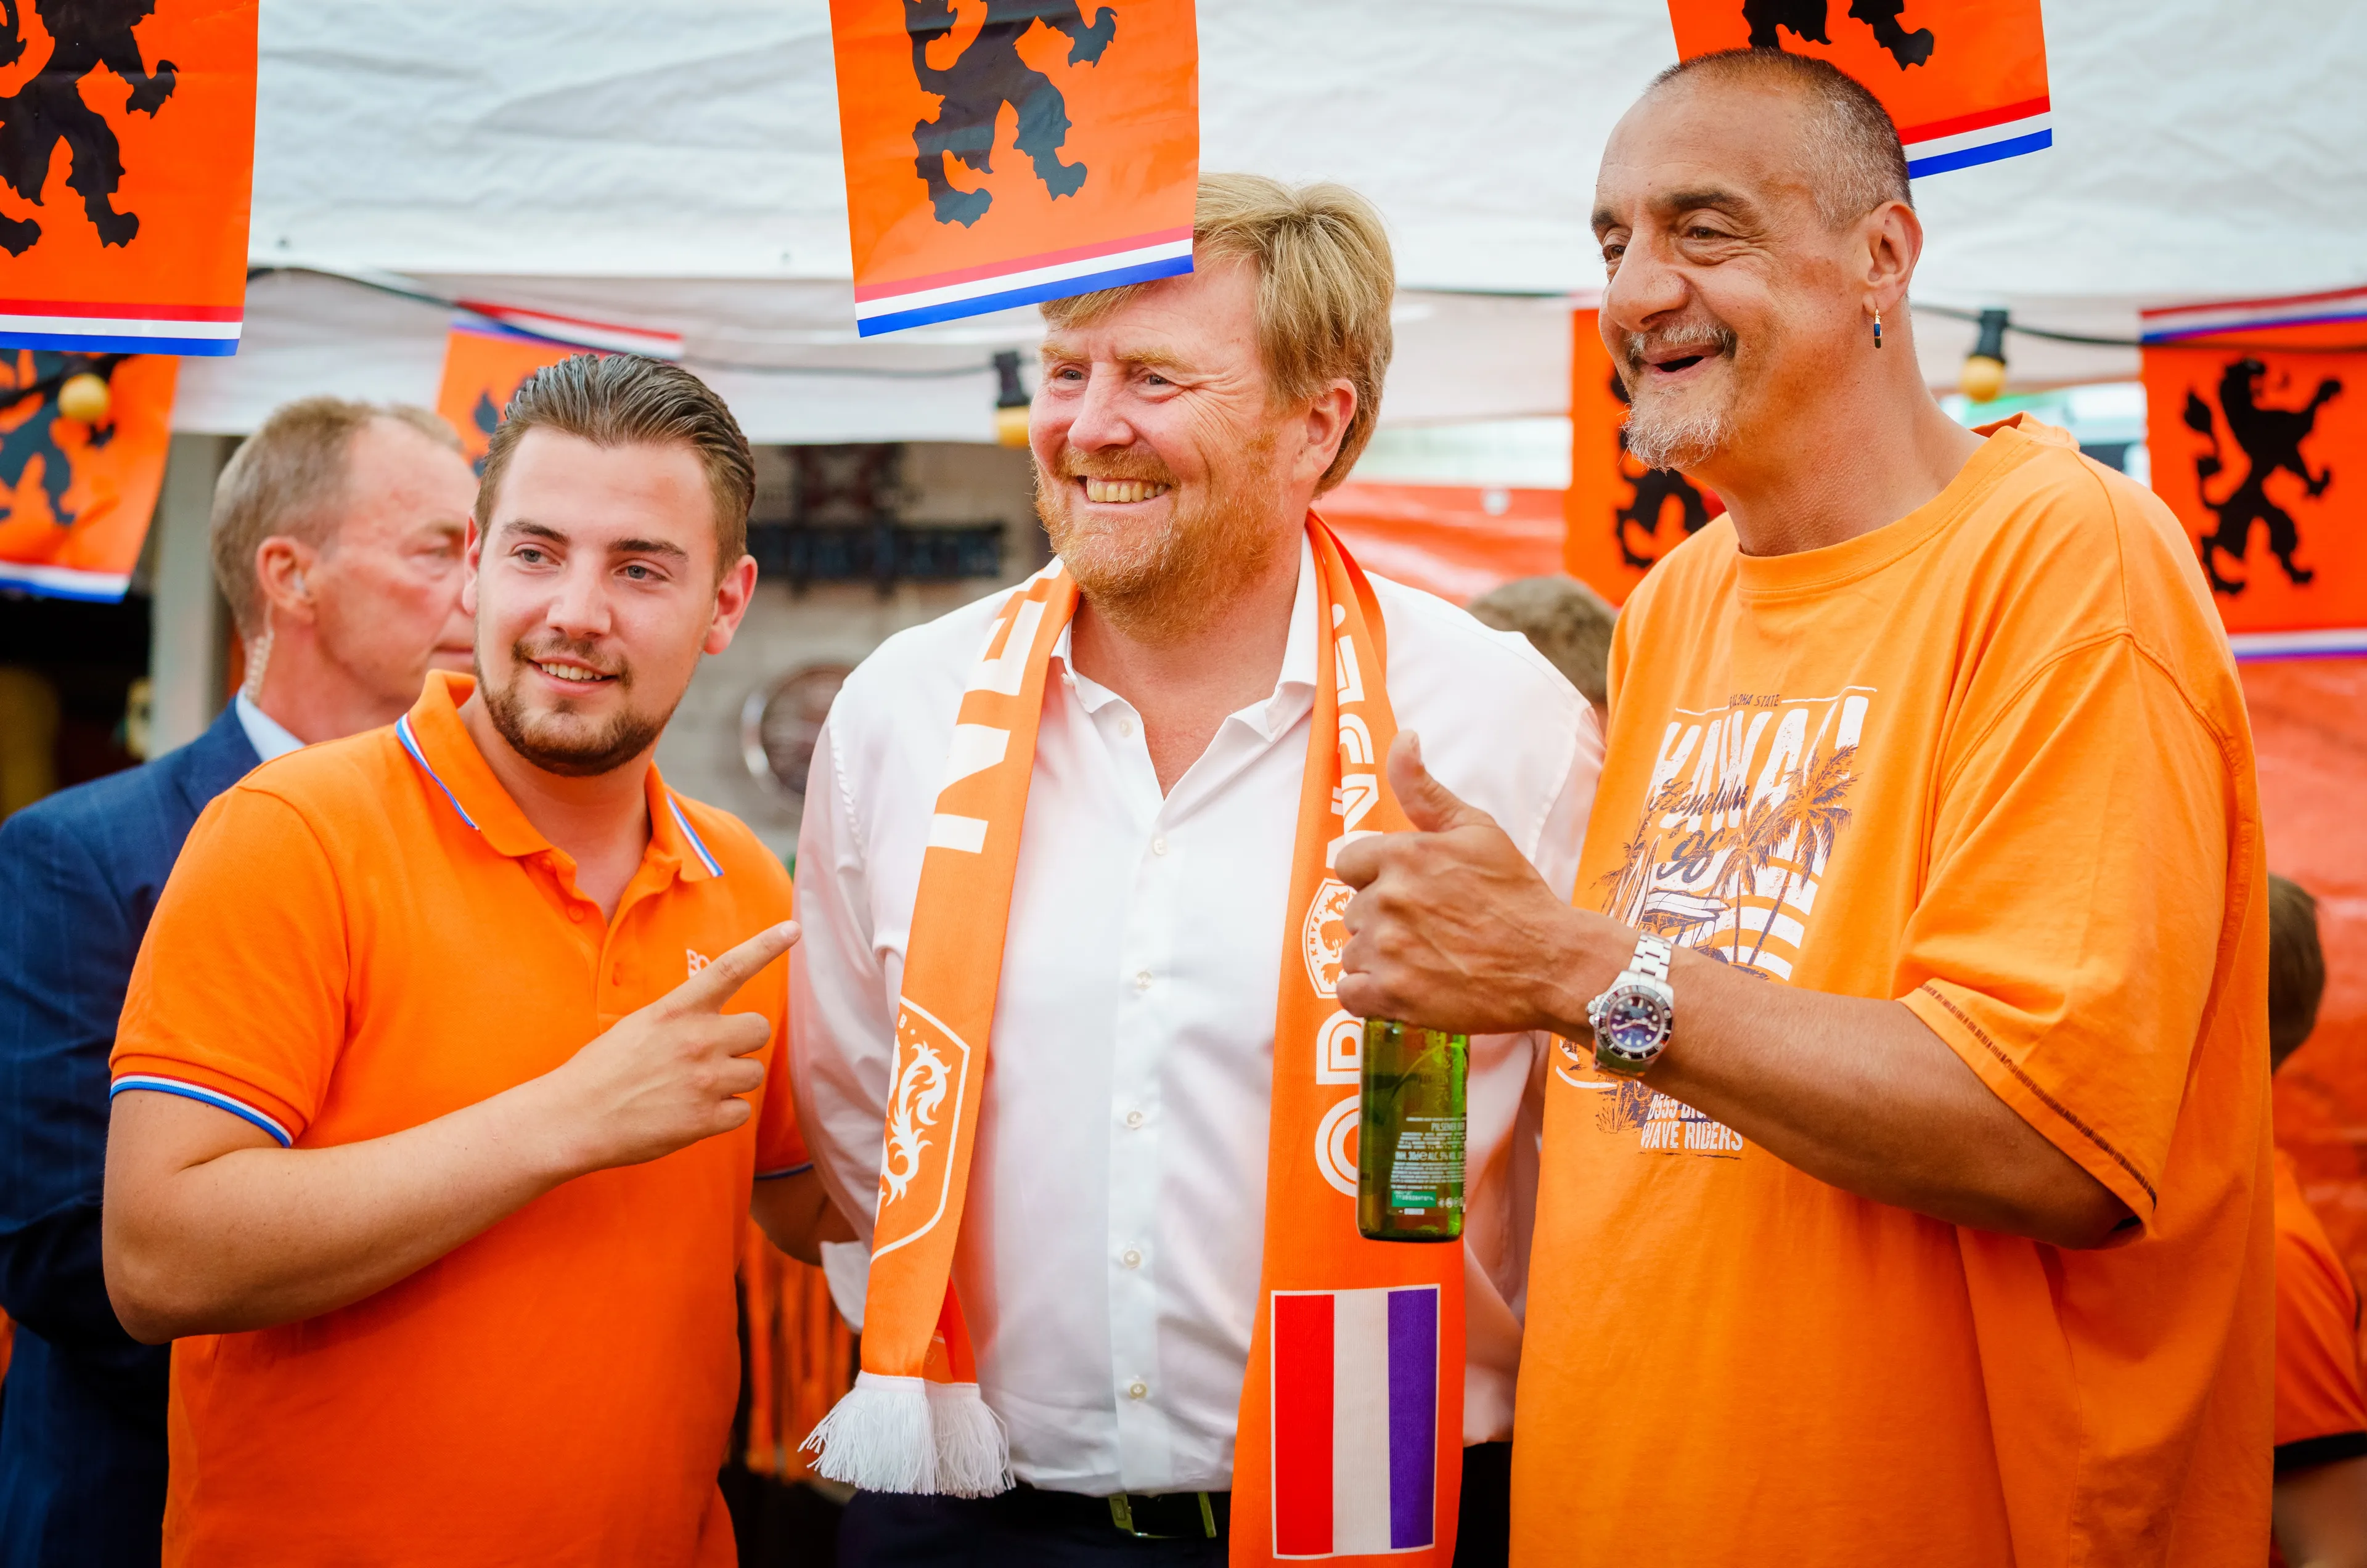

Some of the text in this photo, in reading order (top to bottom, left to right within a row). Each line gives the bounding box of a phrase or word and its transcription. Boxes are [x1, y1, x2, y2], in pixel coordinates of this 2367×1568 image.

[1754, 694, 1780, 707] STATE
[1641, 1121, 1743, 1151] WAVE RIDERS
